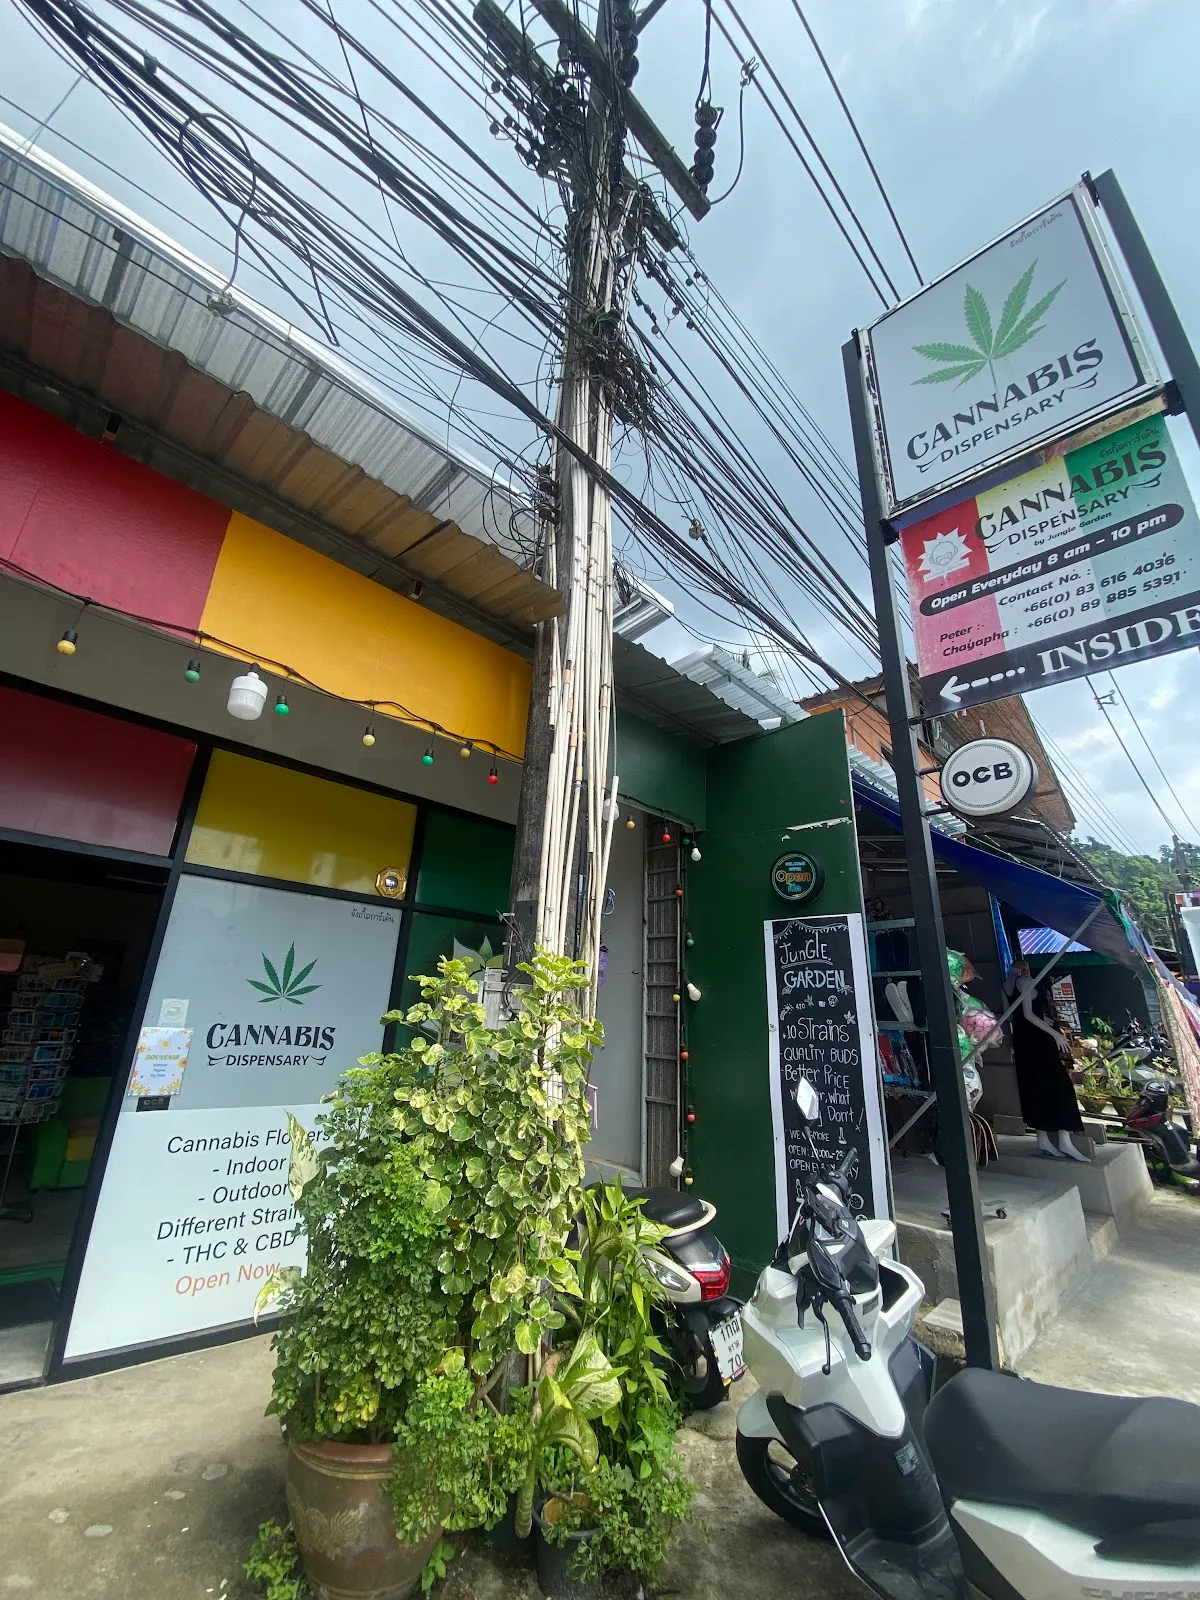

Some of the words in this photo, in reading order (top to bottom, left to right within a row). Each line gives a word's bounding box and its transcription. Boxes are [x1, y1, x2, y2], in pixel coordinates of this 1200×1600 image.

[906, 337, 1104, 460] CANNABIS
[940, 388, 1066, 463] DISPENSARY
[974, 439, 1167, 541] CANNABIS
[1008, 485, 1130, 546] DISPENSARY
[1034, 538, 1045, 546] by
[1048, 526, 1076, 541] Jungle
[1079, 511, 1112, 528] Garden
[931, 589, 967, 609] Open
[971, 560, 1042, 594] Everyday
[1047, 553, 1059, 565] 8
[1063, 542, 1091, 559] am
[1110, 525, 1131, 541] 10
[1137, 513, 1167, 535] pm
[940, 626, 973, 643] Peter
[1023, 590, 1071, 613] +66(0)
[1075, 582, 1095, 596] 83
[1100, 571, 1127, 588] 616
[1132, 554, 1176, 576] 4036
[999, 580, 1054, 606] Contact
[1059, 572, 1081, 586] No.
[942, 630, 1010, 657] Chayapha
[1027, 606, 1075, 629] +66(0)
[1080, 598, 1101, 612] 89
[1106, 585, 1137, 603] 885
[1142, 570, 1181, 592] 5391
[1036, 604, 1200, 676] INSIDE
[952, 762, 1013, 788] OCB
[775, 869, 811, 885] Open
[783, 969, 845, 989] GARDEN
[206, 1022, 336, 1050] CANNABIS
[786, 1024, 797, 1039] 10
[225, 1054, 310, 1066] DISPENSARY
[830, 1047, 859, 1066] BUDS
[167, 1130, 260, 1154] Cannabis
[265, 1128, 331, 1146] Floers
[226, 1156, 287, 1176] Indoor
[789, 1158, 811, 1172] OPEN
[212, 1181, 289, 1204] Outdoor
[156, 1211, 247, 1241] Different
[183, 1240, 228, 1265] THC
[233, 1237, 249, 1256] &
[255, 1230, 297, 1252] CBD
[175, 1271, 230, 1297] Open
[237, 1262, 281, 1283] Now
